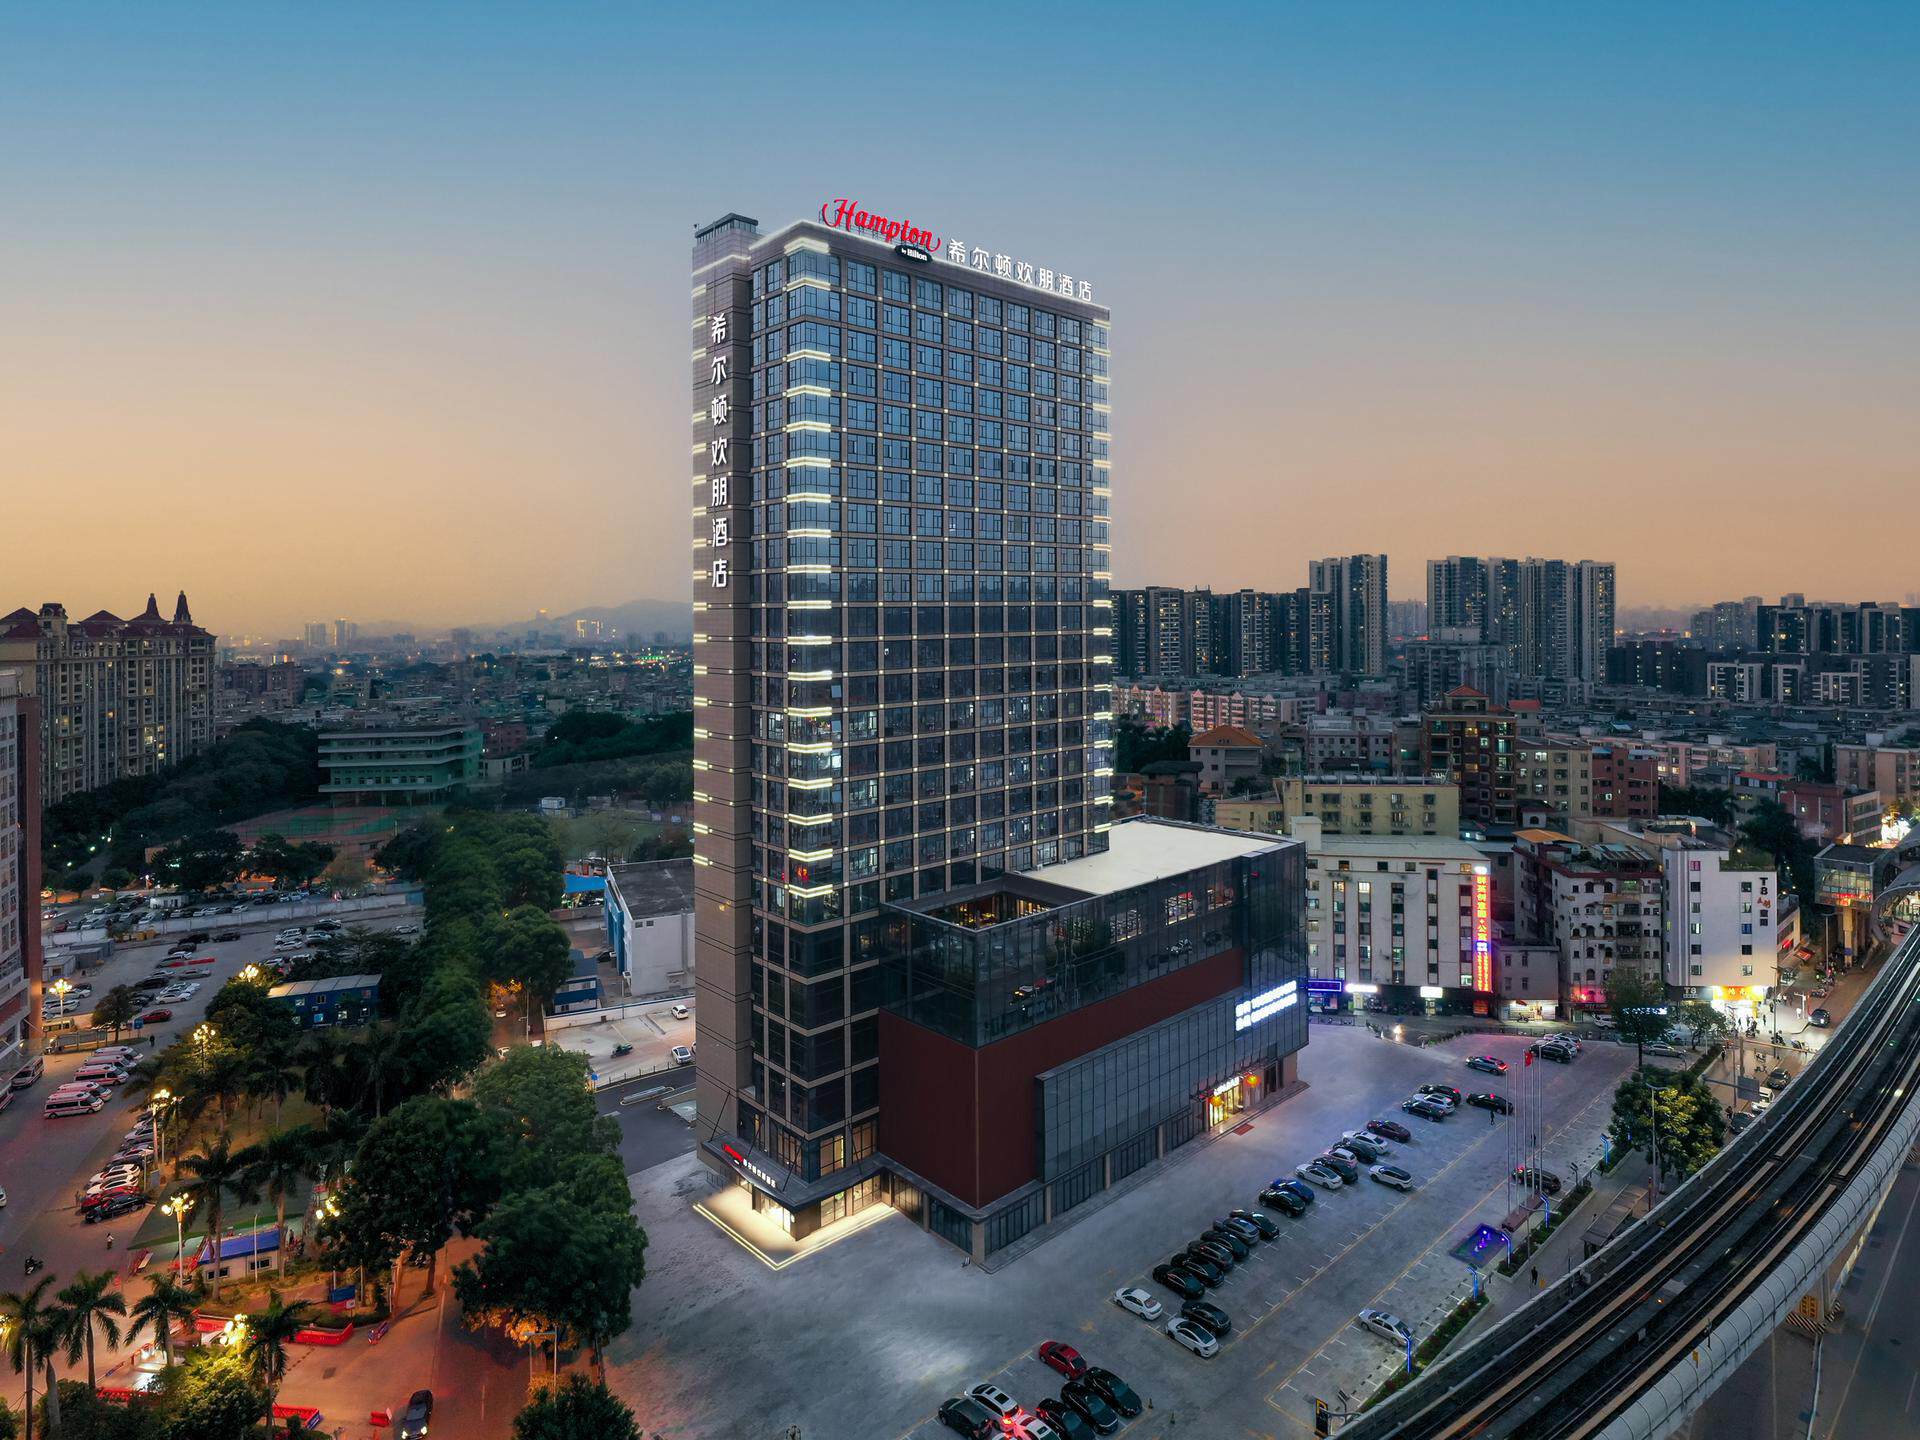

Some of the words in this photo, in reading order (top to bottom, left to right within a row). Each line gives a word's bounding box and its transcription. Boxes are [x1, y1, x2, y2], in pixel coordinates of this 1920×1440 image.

[822, 198, 942, 252] Hampton
[907, 248, 928, 261] Hilton
[949, 238, 1092, 302] 希尔顿欢朋酒店
[711, 312, 728, 588] 希尔顿欢朋酒店
